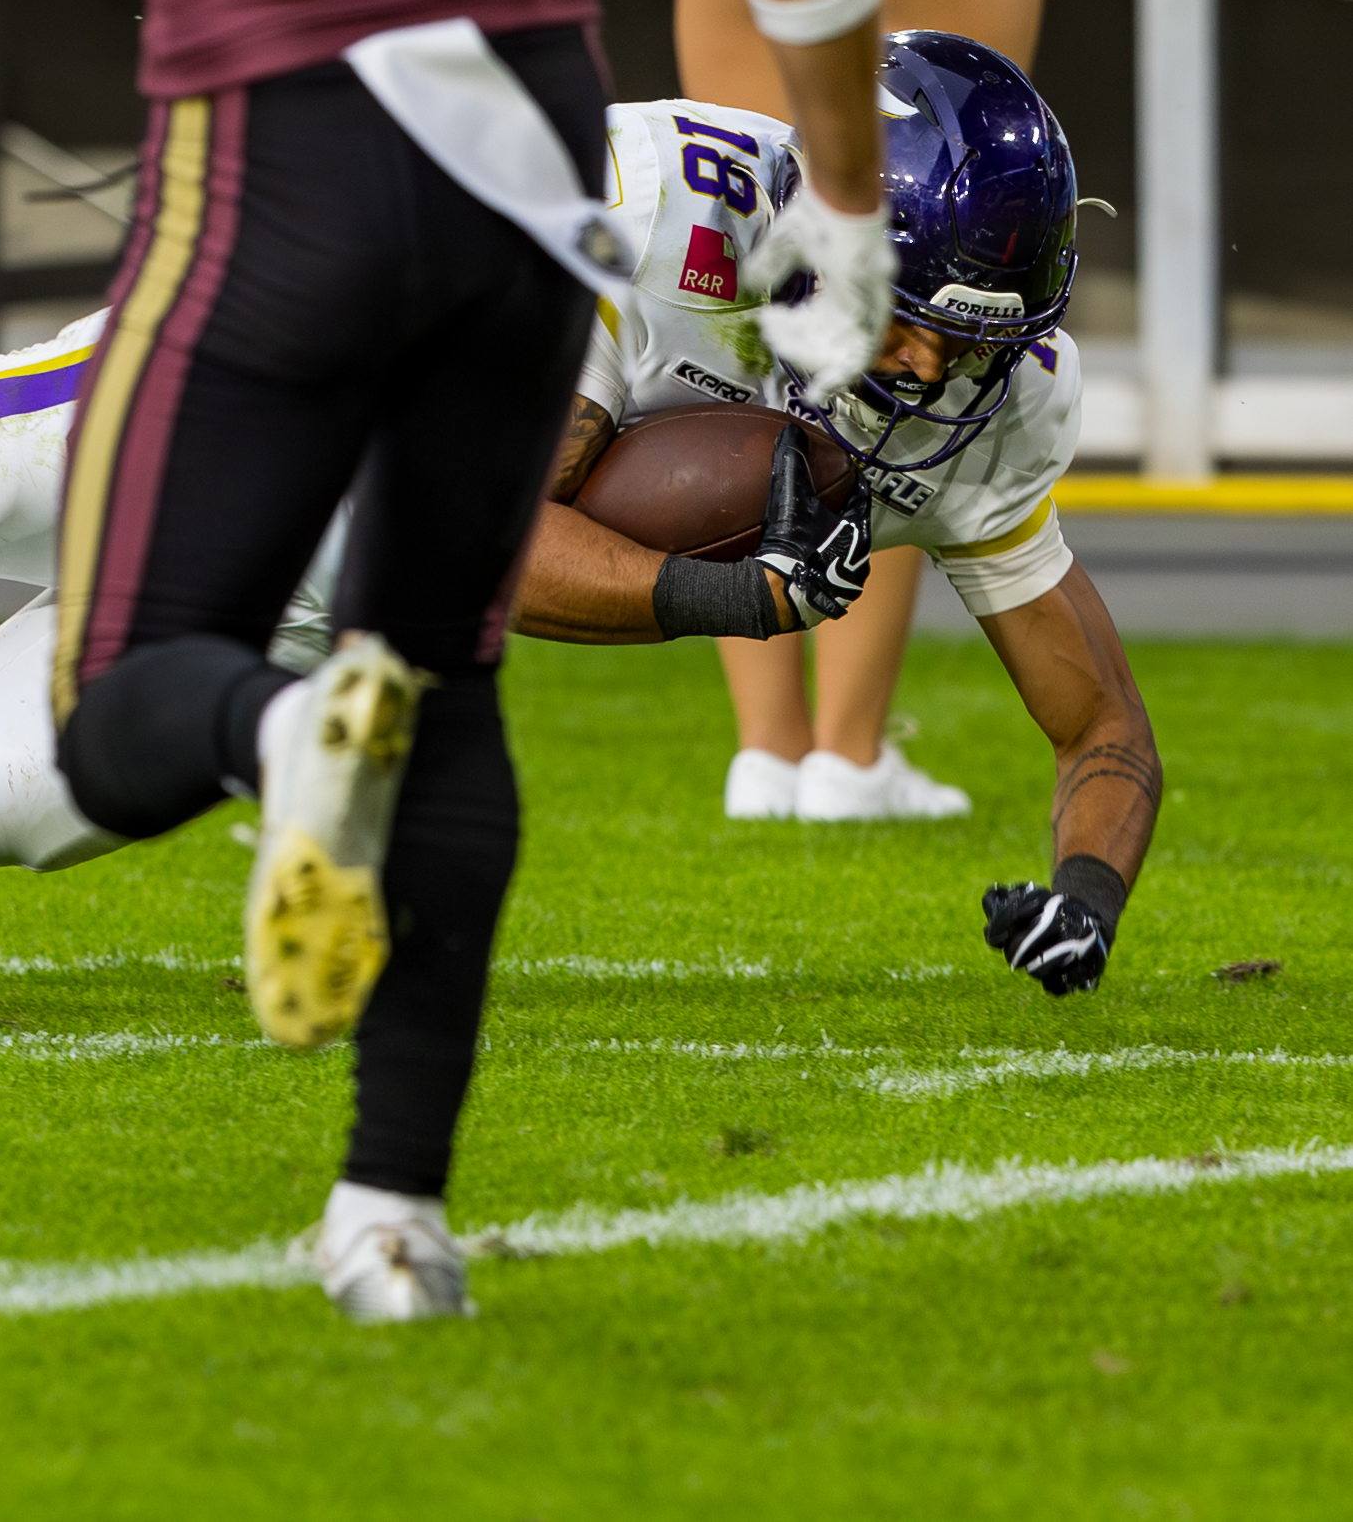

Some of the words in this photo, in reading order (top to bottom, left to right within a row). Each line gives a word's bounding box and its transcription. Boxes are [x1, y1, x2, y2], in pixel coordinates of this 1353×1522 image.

[671, 115, 761, 218] 18
[683, 268, 725, 295] R4R
[945, 298, 1023, 319] FORELLE
[863, 465, 934, 511] AFLE
